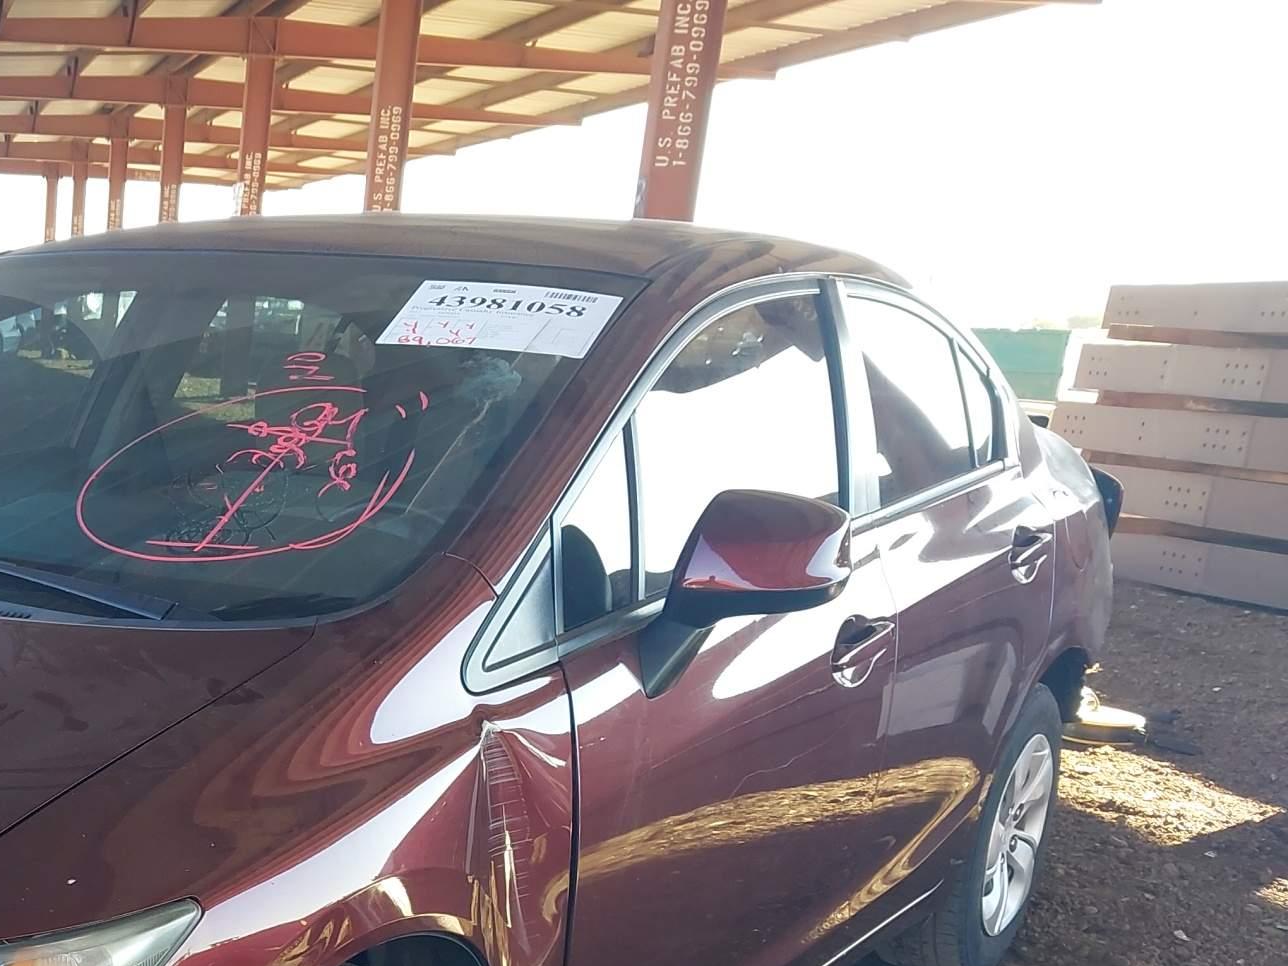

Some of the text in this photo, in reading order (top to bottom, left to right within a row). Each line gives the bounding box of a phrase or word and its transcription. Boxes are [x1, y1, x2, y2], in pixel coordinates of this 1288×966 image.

[662, 42, 687, 120] PREFAB
[672, 0, 711, 167] 1-866-799-0969
[379, 104, 392, 130] INC.
[373, 134, 388, 184] PREFAB
[427, 294, 587, 318] 43981058
